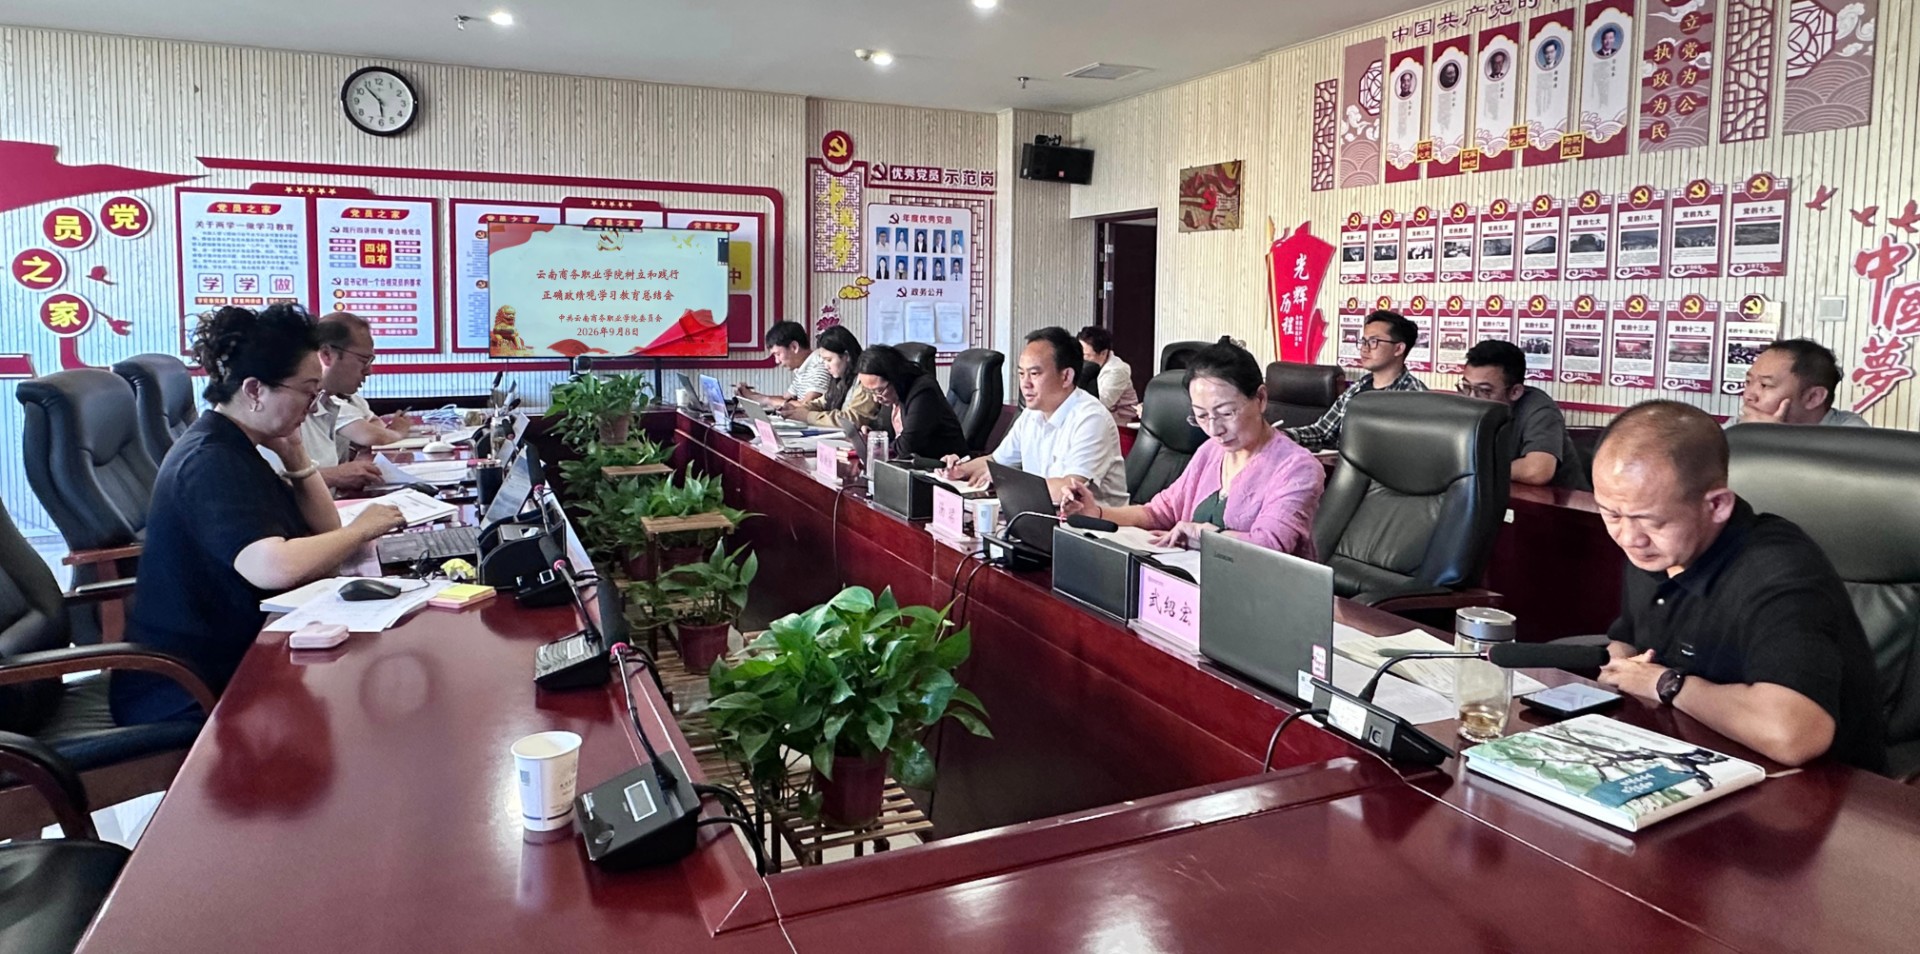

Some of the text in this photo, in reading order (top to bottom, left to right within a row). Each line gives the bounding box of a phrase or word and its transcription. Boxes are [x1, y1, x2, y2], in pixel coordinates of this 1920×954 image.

[1678, 14, 1700, 113] 立党为公
[374, 78, 383, 86] 12
[1651, 45, 1671, 139] 执政为民
[354, 97, 360, 105] 9
[358, 108, 364, 116] 8
[389, 116, 395, 124] 5
[892, 167, 994, 187] 优秀党员 示范岗
[217, 203, 271, 214] 党员之家
[350, 209, 400, 219] 党员之家
[902, 214, 952, 224] 年度优秀党员
[195, 221, 294, 231] 关于两学一做学习教育
[693, 222, 733, 230] 党员之家
[364, 243, 387, 253] 四讲
[21, 203, 140, 327] 党员之家
[364, 255, 387, 265] 四有
[536, 268, 680, 280] 云南商务职业学院树立和践行
[203, 277, 290, 291] 学 学 做
[1292, 253, 1310, 312] 光辉
[542, 289, 674, 301] 正确政绩观学习教育总结会
[911, 288, 943, 297] 政务公开
[558, 313, 663, 323] 中共云南商务职业学院委员会
[1279, 292, 1295, 335] 历程
[577, 327, 639, 337] 2026年9月8日
[1149, 588, 1192, 626] 武绍宏
